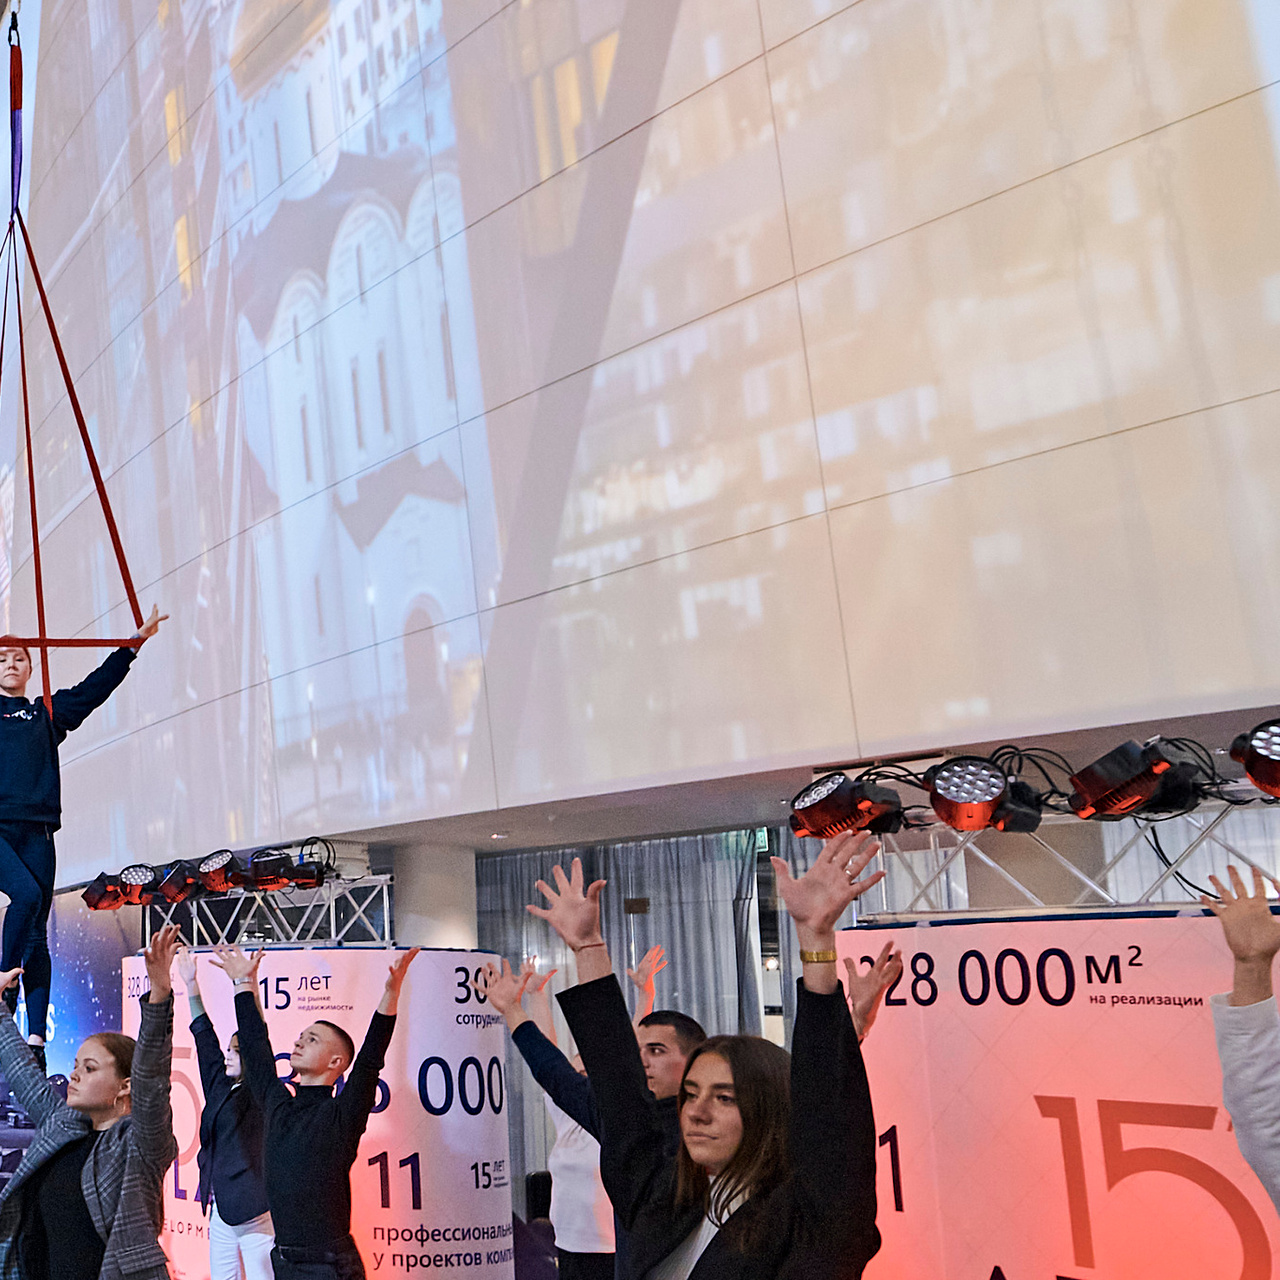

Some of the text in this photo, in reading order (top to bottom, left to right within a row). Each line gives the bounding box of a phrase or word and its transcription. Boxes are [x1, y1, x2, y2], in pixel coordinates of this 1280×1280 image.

[259, 975, 332, 1010] 15 лет
[454, 966, 492, 1004] 30
[958, 948, 1076, 1007] 000
[1089, 995, 1203, 1008] на реализации
[418, 1056, 503, 1116] 000
[368, 1151, 422, 1211] 11
[471, 1162, 491, 1189] 15
[373, 1252, 384, 1270] у
[392, 1252, 482, 1272] проектов
